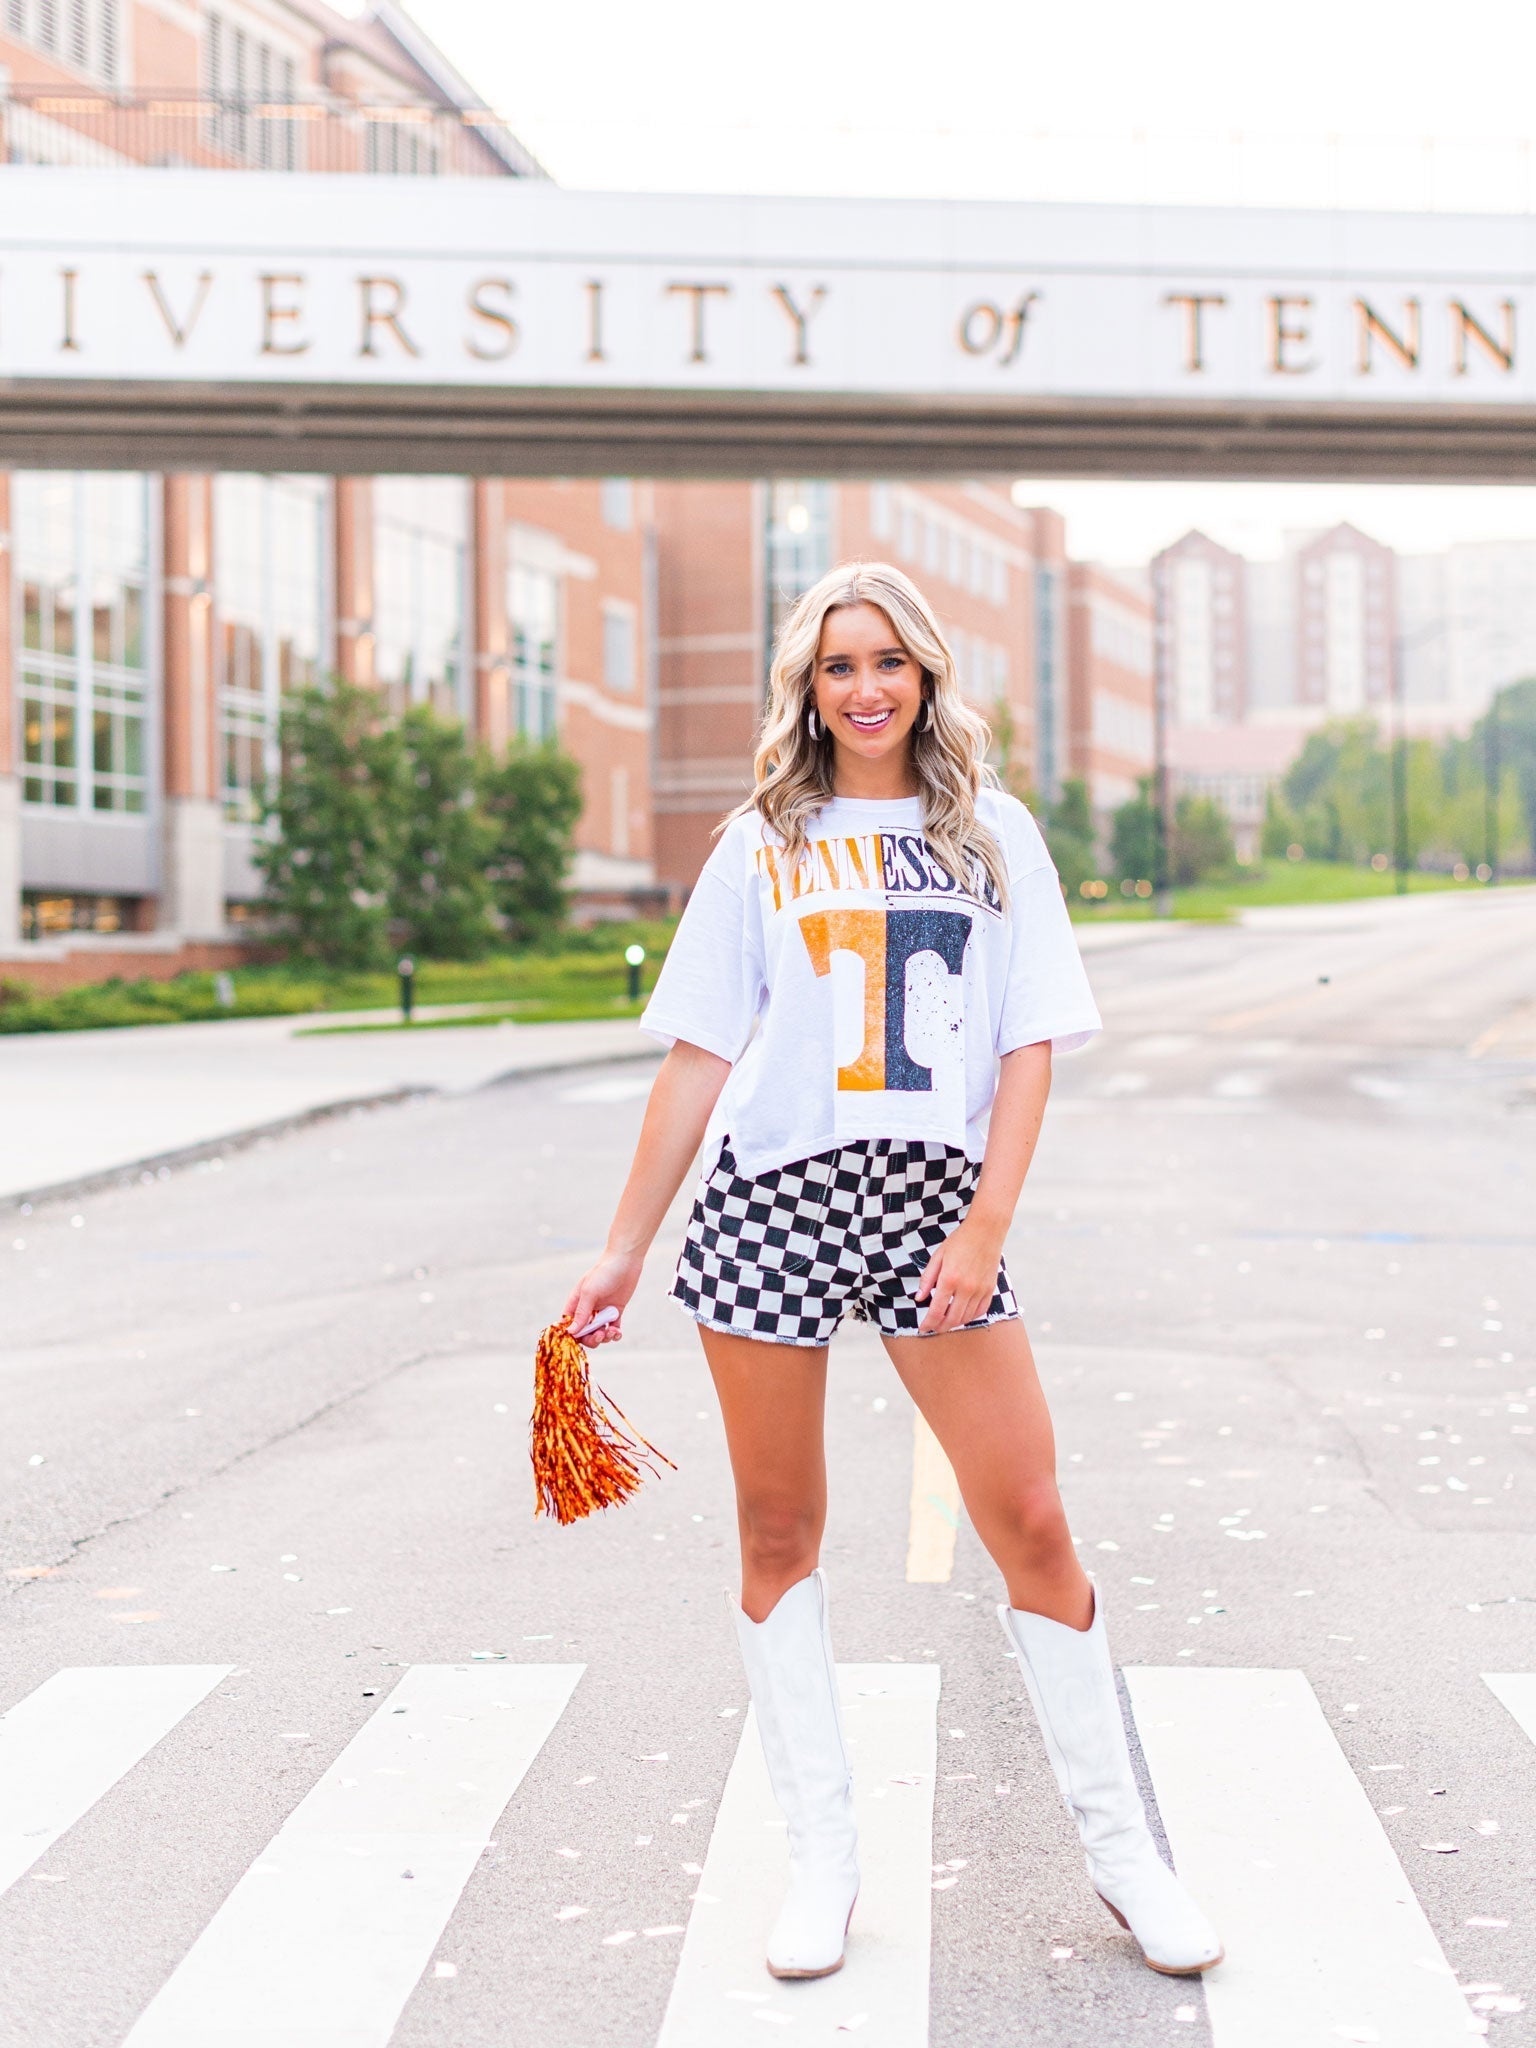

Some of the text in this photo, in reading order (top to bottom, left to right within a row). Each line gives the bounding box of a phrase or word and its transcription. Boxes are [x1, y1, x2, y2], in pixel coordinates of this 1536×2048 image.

[957, 290, 1043, 369] of
[1162, 291, 1518, 377] TENN
[798, 909, 973, 1091] T
